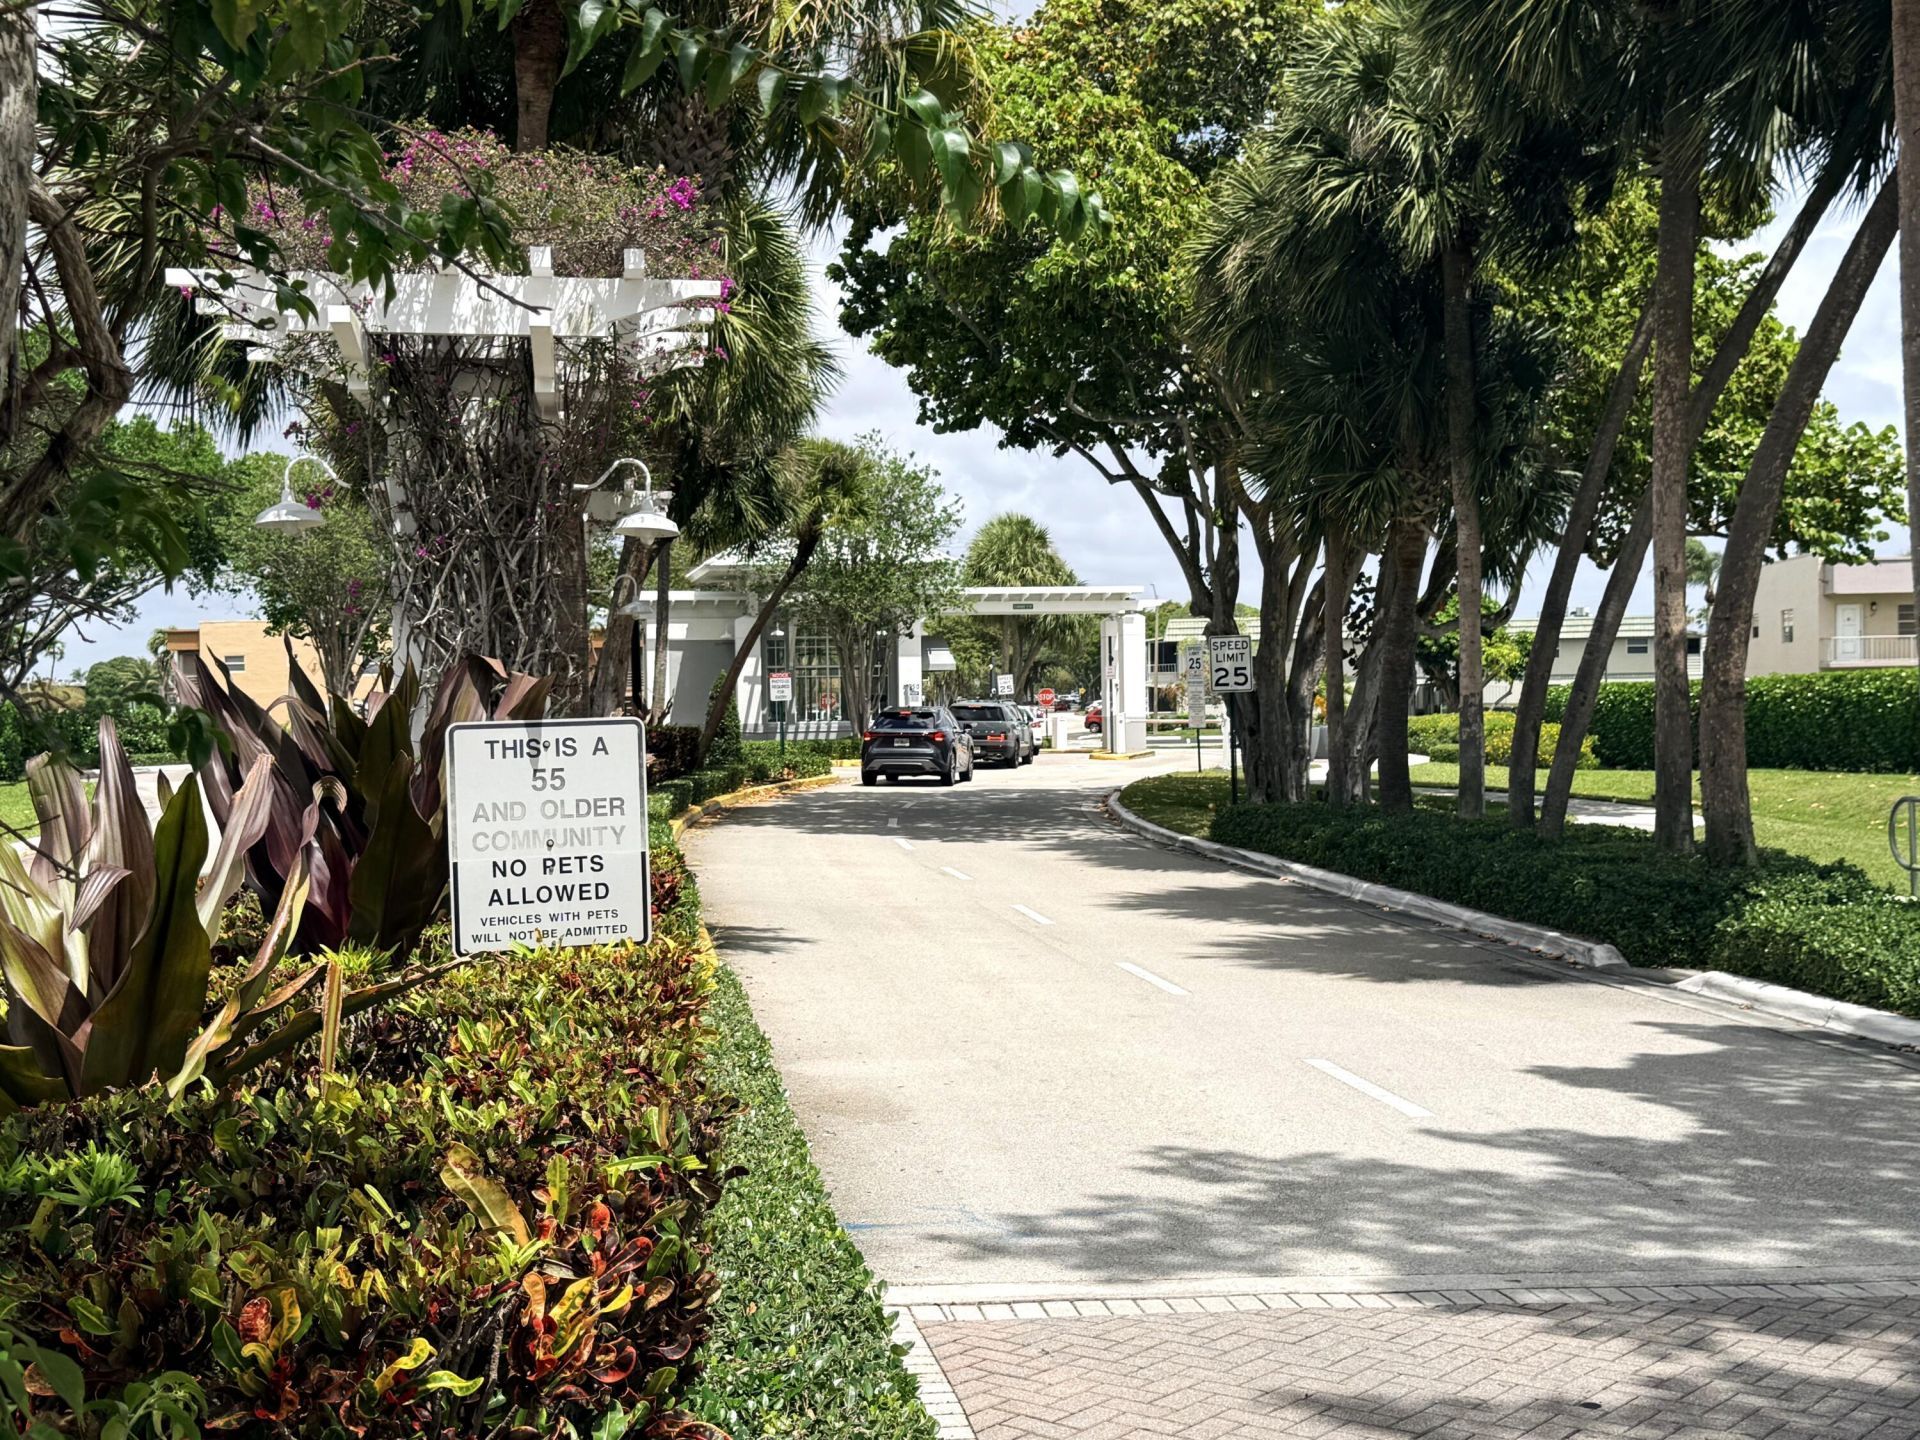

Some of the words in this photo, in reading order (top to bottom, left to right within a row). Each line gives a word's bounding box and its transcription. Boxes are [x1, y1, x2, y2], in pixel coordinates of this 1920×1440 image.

[1212, 640, 1249, 650] SPEED
[1188, 657, 1201, 669] 25
[1215, 652, 1245, 663] LIMIT
[1214, 667, 1249, 686] 25
[999, 685, 1013, 693] 25
[1038, 693, 1055, 701] STOP
[484, 738, 542, 760] THIS
[555, 737, 578, 757] IS
[592, 736, 609, 756] A
[531, 767, 566, 791] 55
[472, 801, 527, 823] AND
[540, 797, 626, 820] OLDER
[471, 825, 626, 852] COMMUNITY
[492, 859, 527, 878] NO
[543, 854, 604, 876] PETS
[488, 882, 610, 907] ALLOWED
[480, 913, 542, 927] VEHICLES
[549, 911, 580, 922] WITH
[587, 909, 619, 919] PETS
[471, 933, 502, 944] WILL
[509, 930, 535, 941] NOT
[541, 928, 558, 939] BE
[565, 924, 628, 937] ADMITTED
